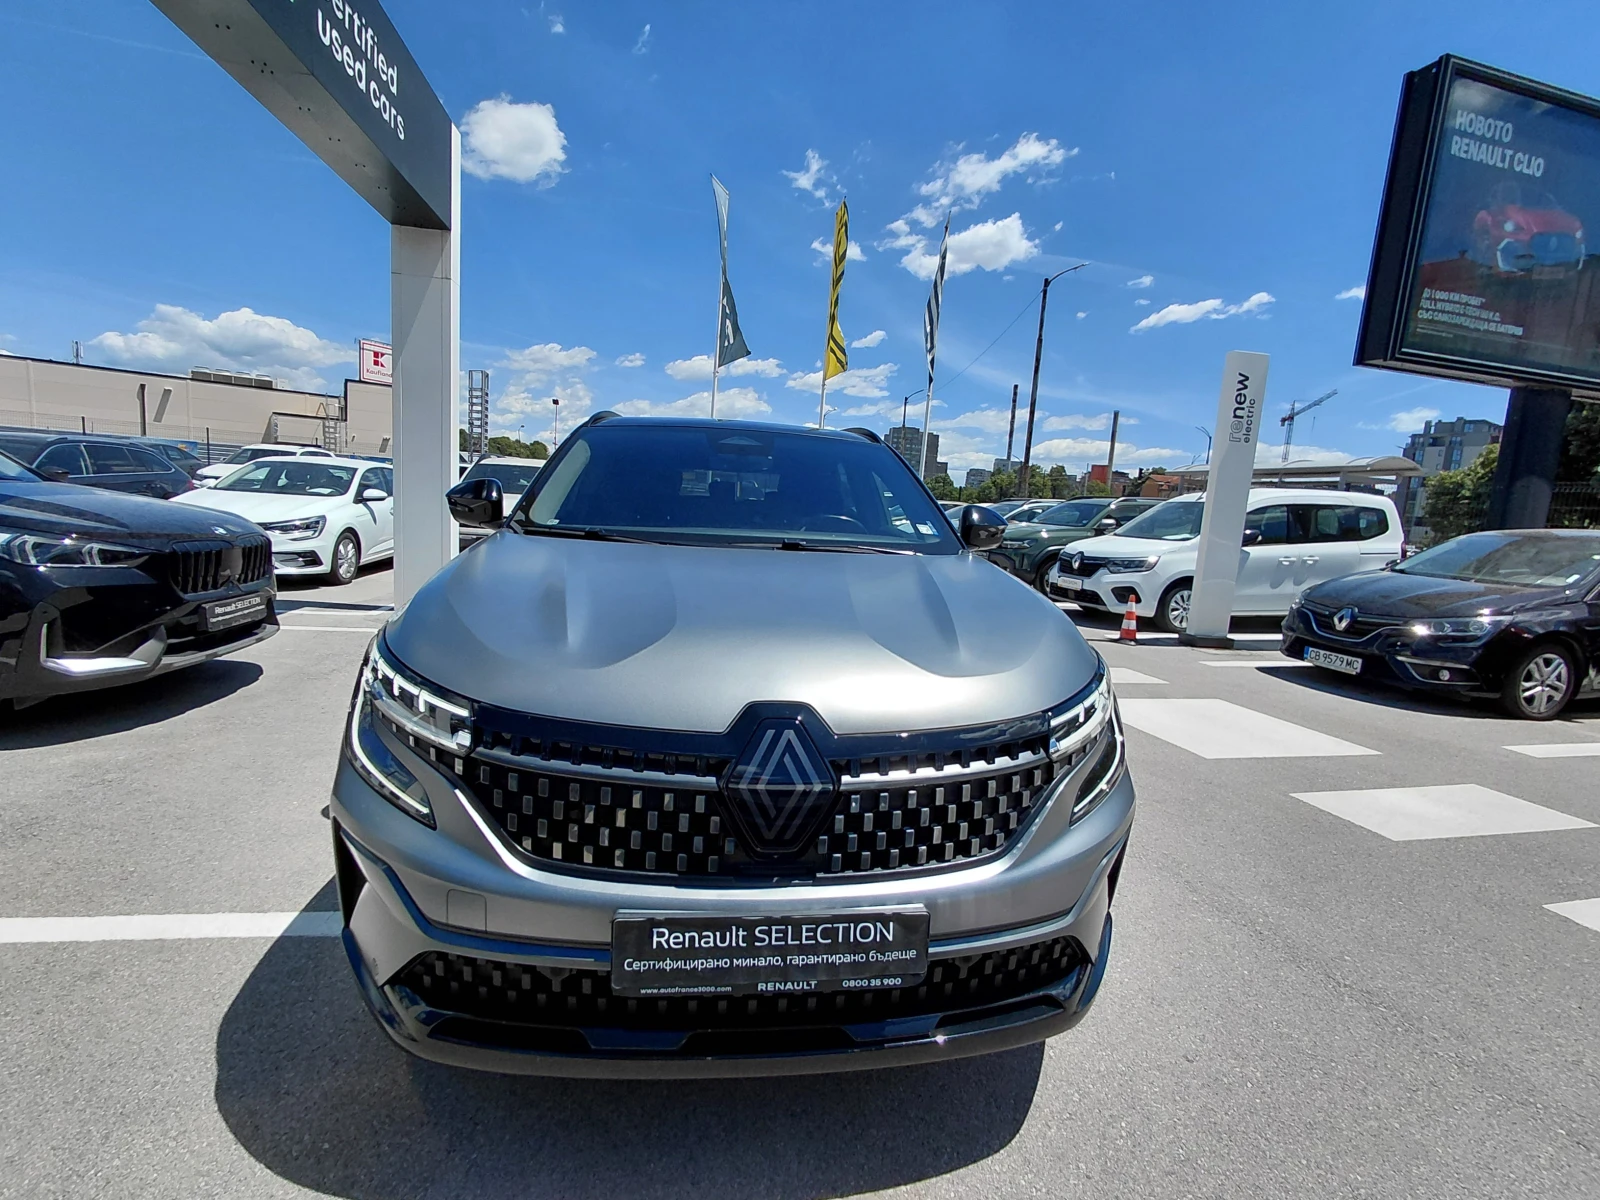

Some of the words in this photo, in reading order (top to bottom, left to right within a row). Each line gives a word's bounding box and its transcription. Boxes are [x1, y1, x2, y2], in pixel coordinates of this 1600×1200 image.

[325, 0, 398, 96] ertified
[369, 80, 405, 140] cars
[1455, 110, 1513, 142] НОВОТО
[1450, 135, 1513, 169] RENAULT
[1513, 152, 1545, 177] CLIO
[1228, 371, 1250, 443] renew
[1242, 398, 1256, 444] electric
[214, 603, 236, 615] Renault
[235, 597, 261, 609] SELECTION
[1309, 649, 1321, 661] CB
[1322, 652, 1345, 667] 9579
[1345, 657, 1360, 670] MC
[652, 925, 748, 949] Renault
[754, 921, 894, 946] SELECTION
[624, 957, 730, 973] Сертифицирано
[732, 956, 784, 968] минало,
[786, 952, 866, 968] гарантирано
[868, 949, 917, 962] бъдеще
[640, 985, 732, 995] www.autofrance3000.com
[757, 980, 818, 992] RENAULT
[842, 978, 868, 988] 0800
[869, 978, 881, 987] 35
[882, 976, 902, 987] 900
